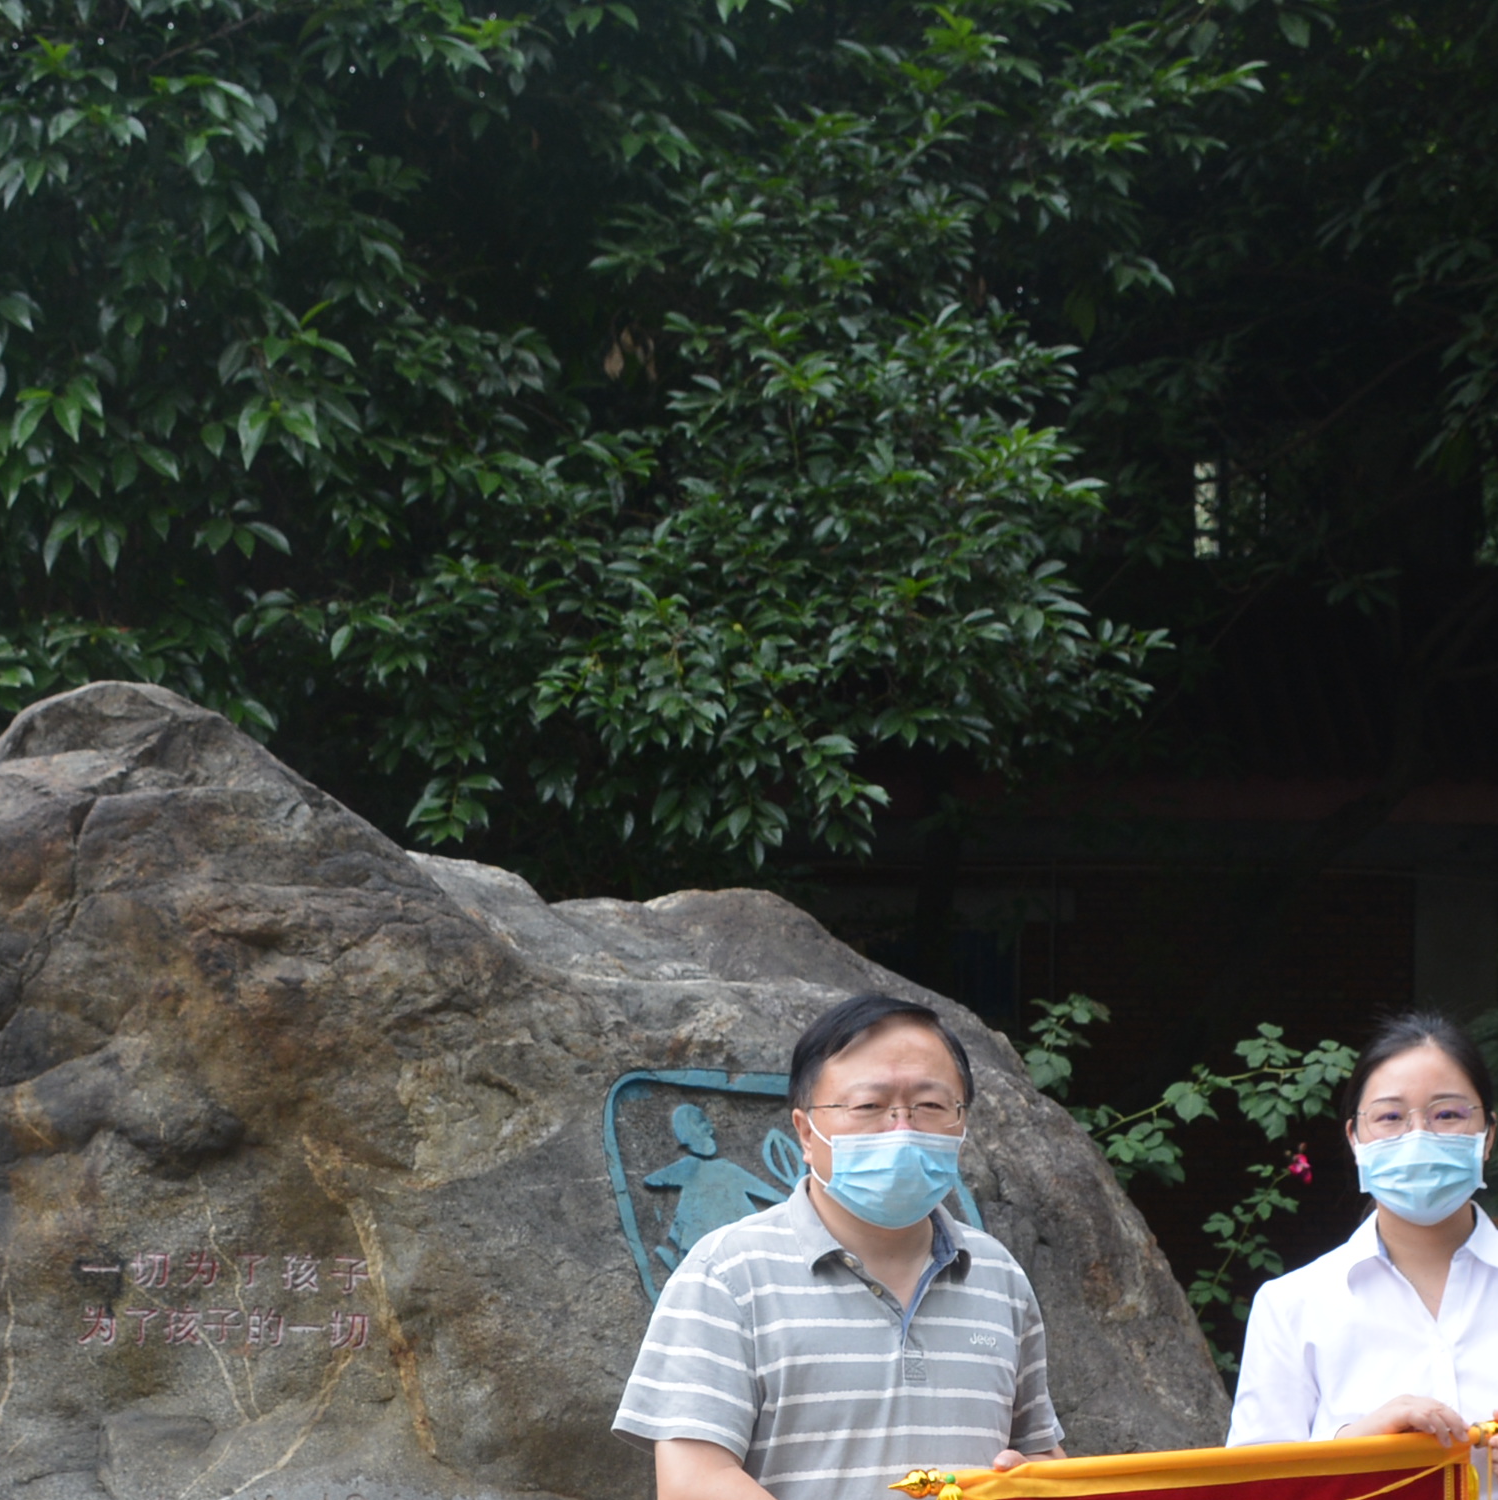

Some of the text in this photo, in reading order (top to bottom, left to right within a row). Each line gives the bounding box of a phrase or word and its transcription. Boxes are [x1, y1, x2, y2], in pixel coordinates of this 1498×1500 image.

[80, 1251, 370, 1294] 一切为了孩子
[78, 1305, 369, 1349] 为了孩子的一切
